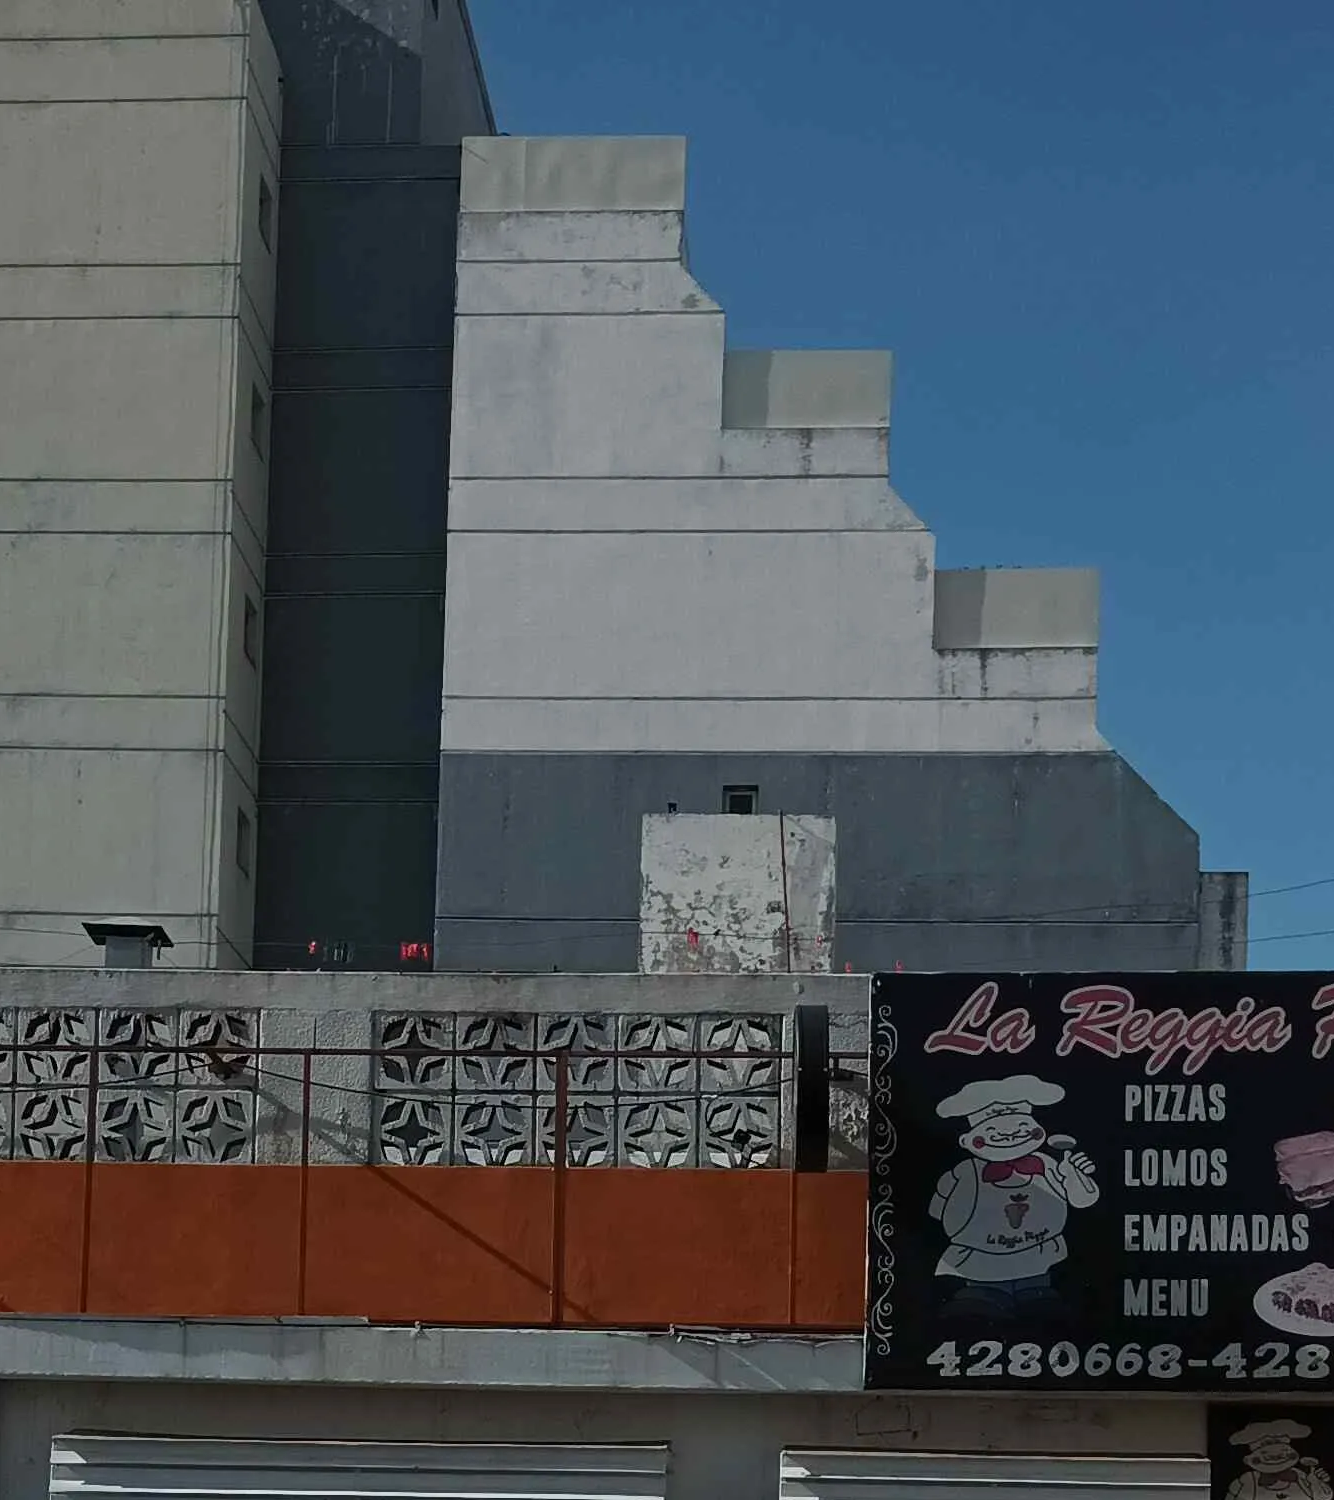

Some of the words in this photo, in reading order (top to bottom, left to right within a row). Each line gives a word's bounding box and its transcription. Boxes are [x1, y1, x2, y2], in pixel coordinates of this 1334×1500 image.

[924, 981, 1036, 1056] La
[1056, 984, 1292, 1076] Reggia
[1124, 1083, 1227, 1123] PIZZAS
[1123, 1148, 1228, 1188] LOMOS
[1123, 1213, 1310, 1254] EMPANADAS
[1123, 1278, 1210, 1318] MENU
